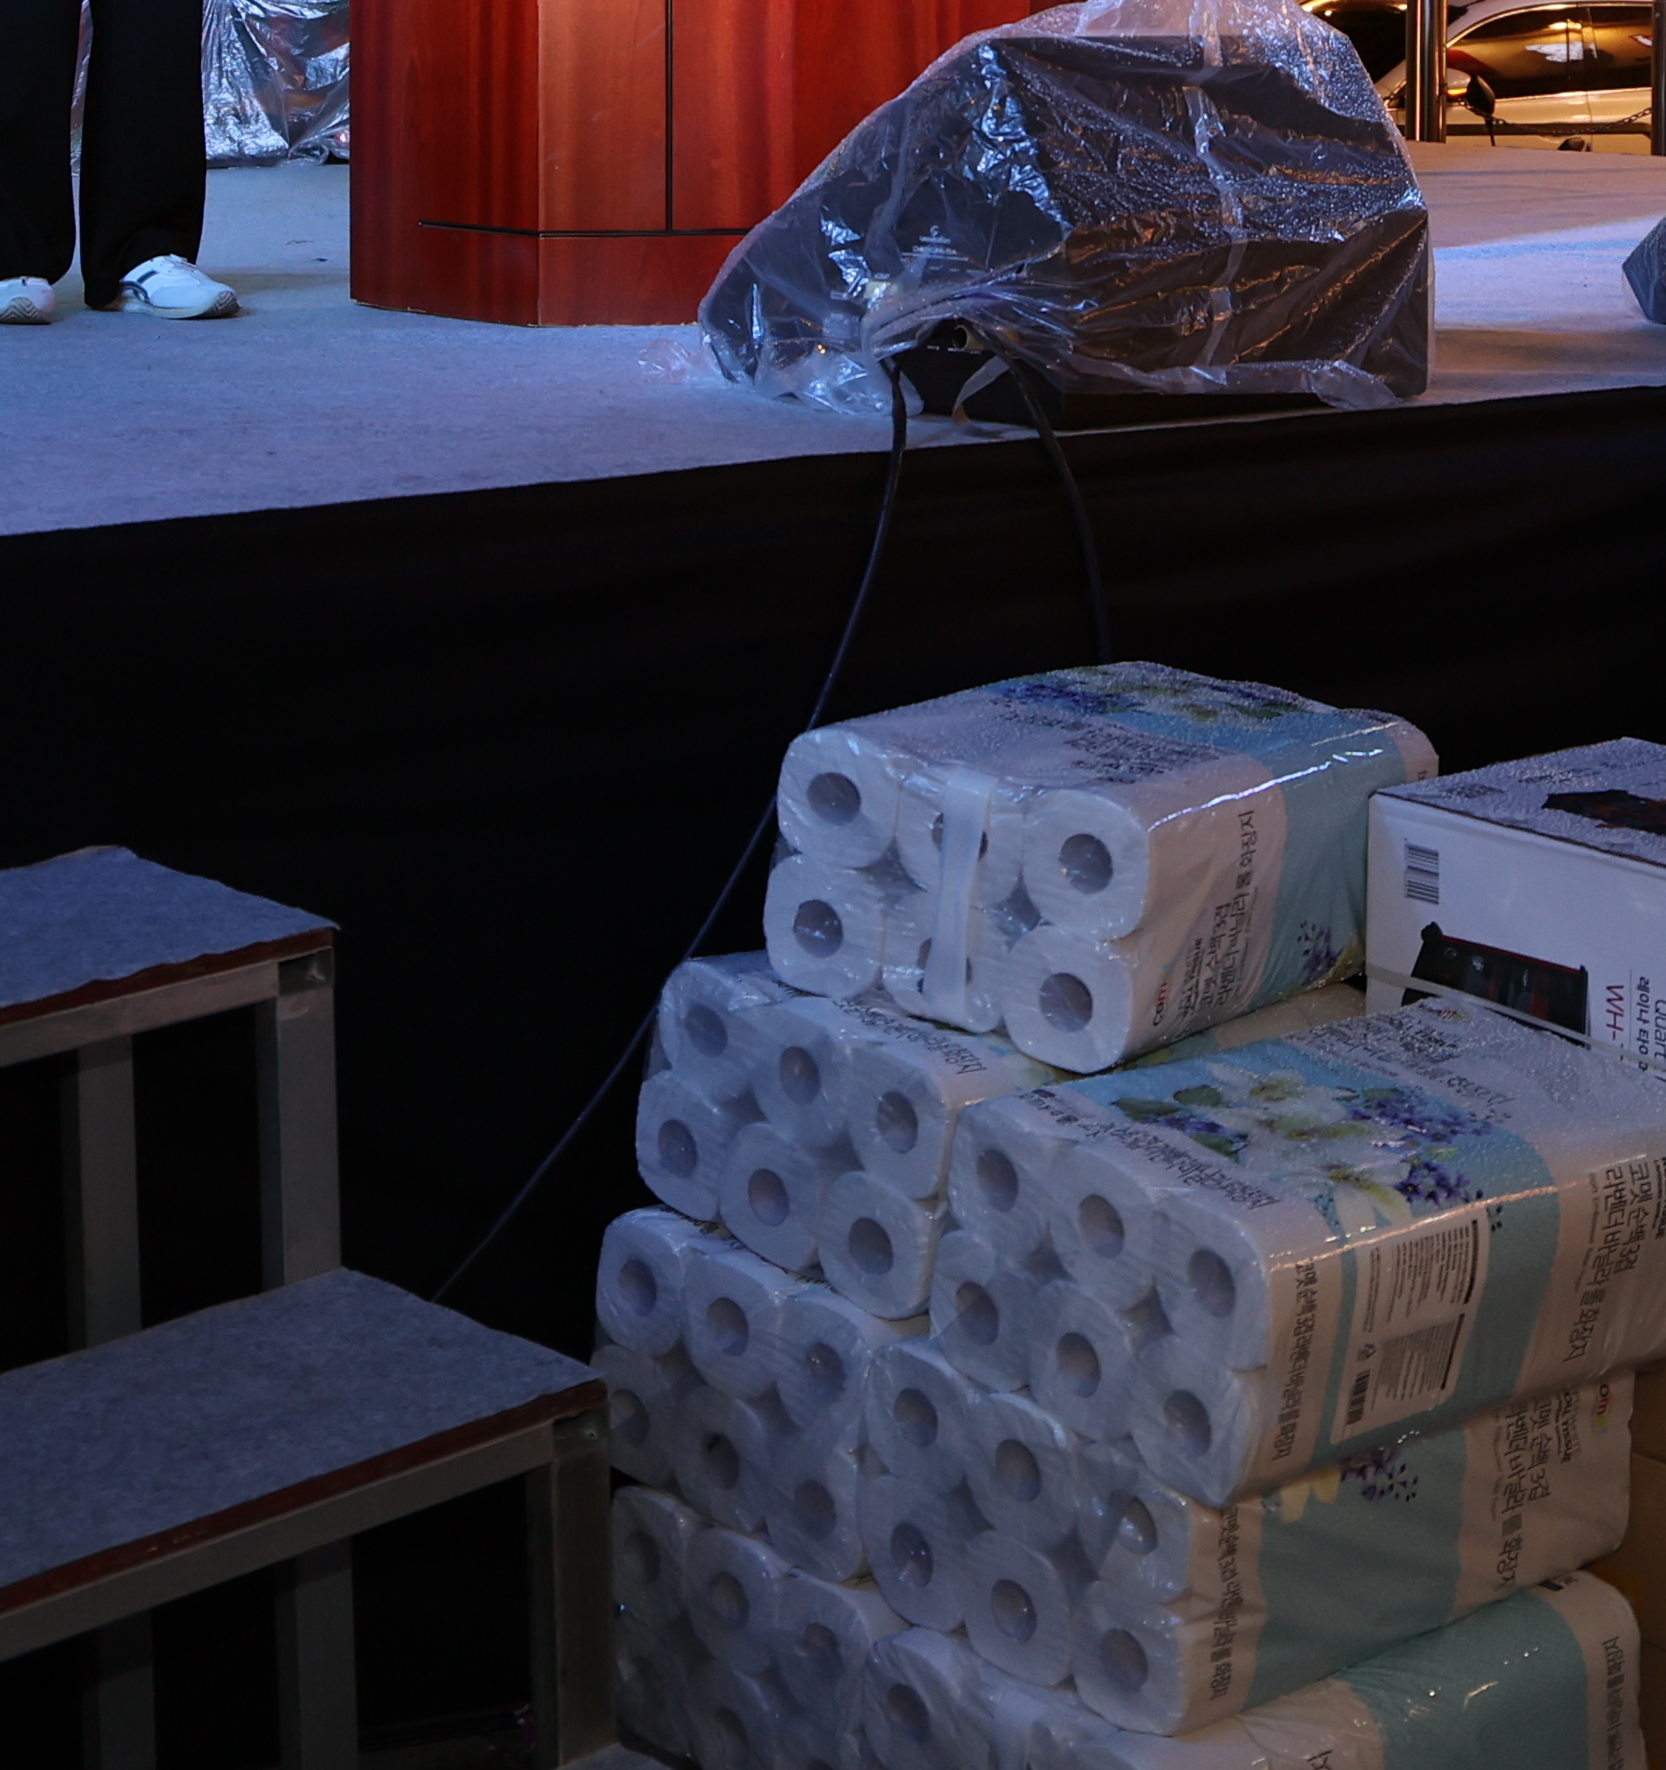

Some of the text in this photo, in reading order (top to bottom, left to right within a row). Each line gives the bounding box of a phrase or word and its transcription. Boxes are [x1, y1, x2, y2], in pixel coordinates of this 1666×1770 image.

[1601, 1167, 1625, 1230] 라벤더
[1627, 1162, 1650, 1203] 코멧
[1587, 1232, 1620, 1287] 바닐라
[1563, 1308, 1595, 1363] 화장지
